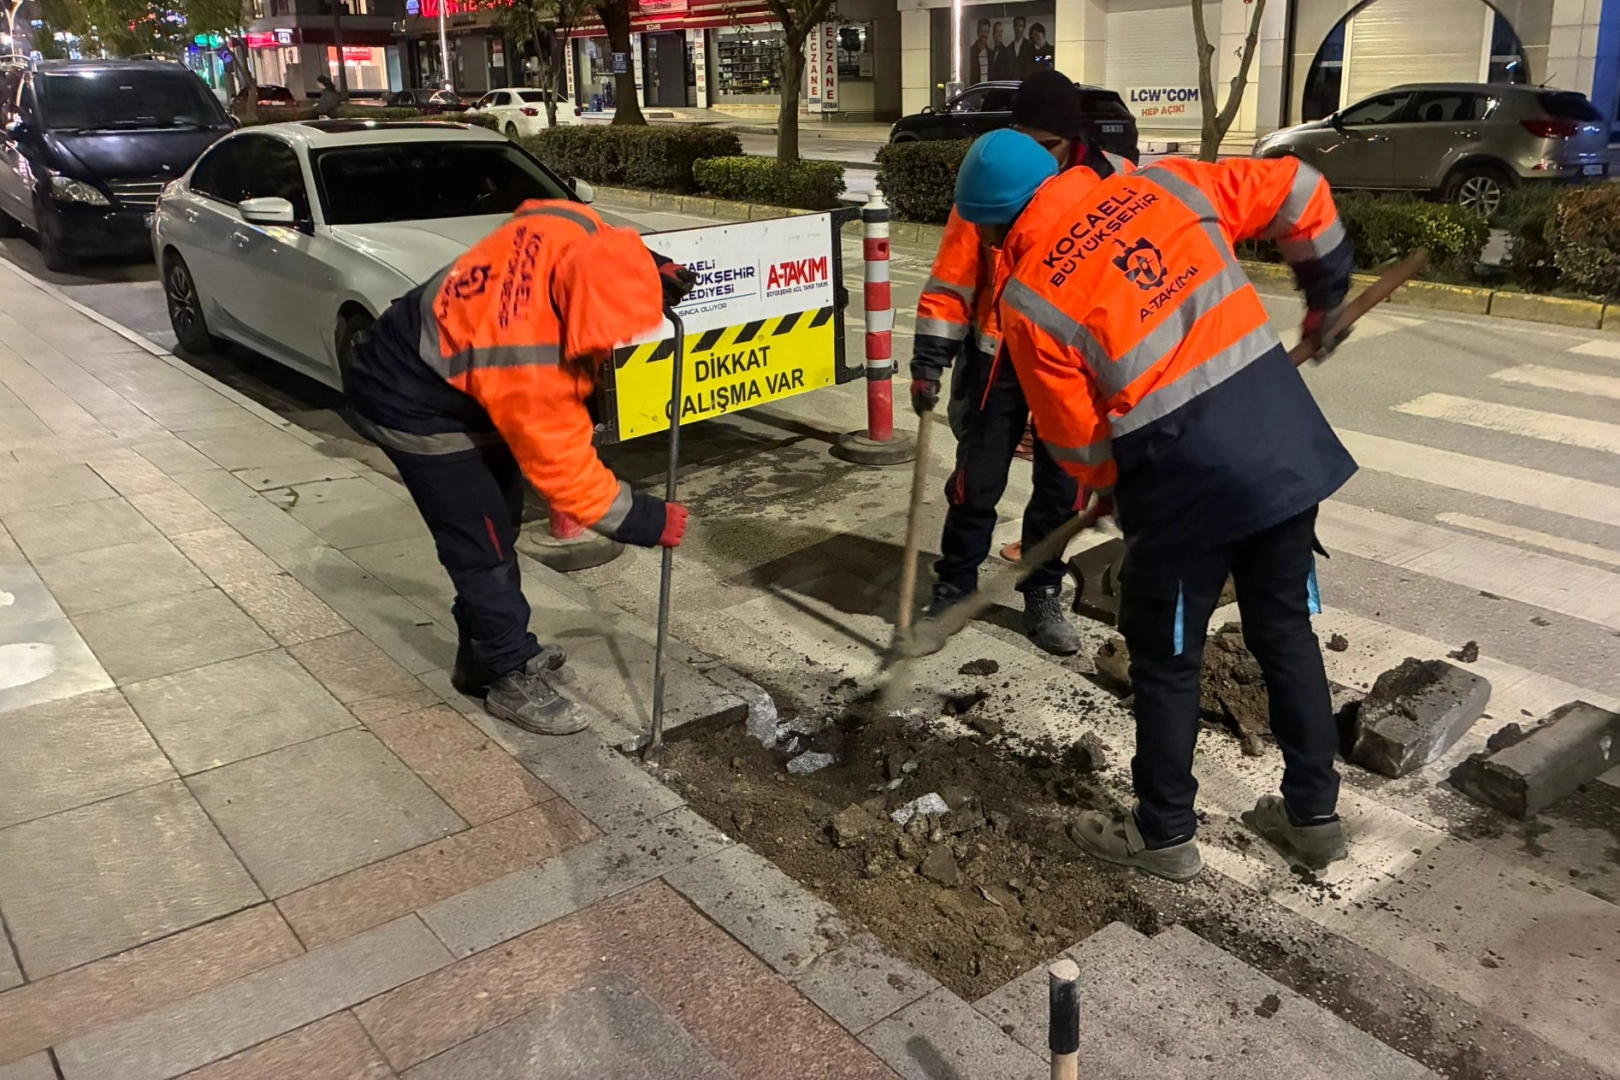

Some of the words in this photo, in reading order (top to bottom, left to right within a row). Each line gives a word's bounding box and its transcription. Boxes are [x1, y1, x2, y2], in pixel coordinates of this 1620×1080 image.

[810, 31, 818, 96] ECZANE
[825, 27, 834, 99] ECZANE
[1141, 107, 1159, 117] HEP
[1160, 104, 1185, 115] AÇIK!
[1042, 187, 1138, 269] KOCAELİ
[1049, 193, 1160, 287] BÜYÜKŞEHİR
[688, 259, 716, 272] AELİ
[695, 266, 755, 286] ÜKŞEHİR
[681, 284, 735, 302] LEDİYESİ
[700, 303, 727, 313] OLUYOR
[694, 345, 771, 383] DİKKAT
[765, 368, 805, 396] VAR
